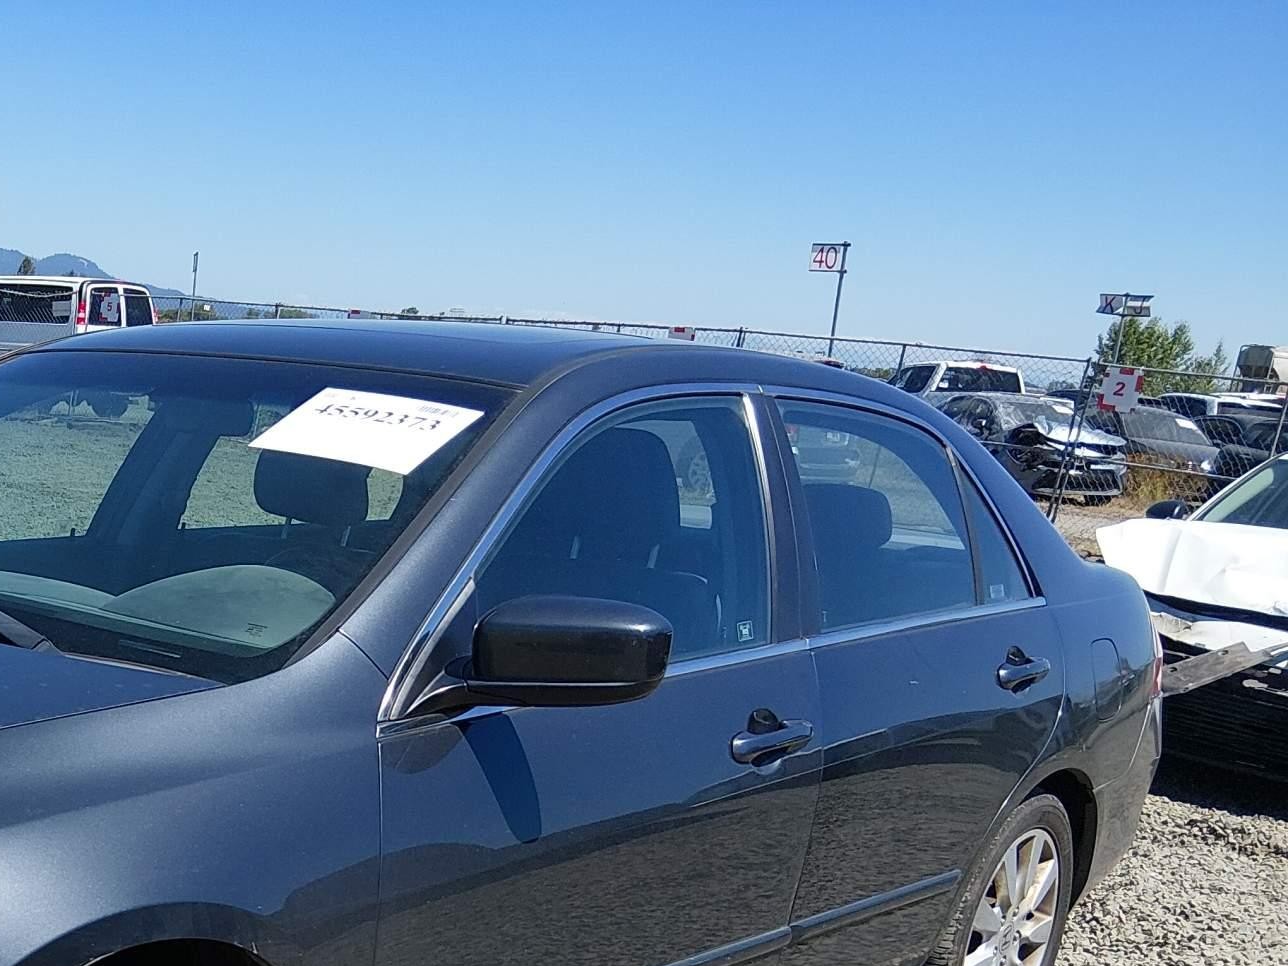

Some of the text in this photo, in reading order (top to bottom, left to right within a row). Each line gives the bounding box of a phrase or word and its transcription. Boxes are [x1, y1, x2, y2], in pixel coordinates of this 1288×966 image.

[813, 246, 838, 269] 40
[106, 302, 113, 312] 5
[1103, 295, 1116, 314] K
[1134, 297, 1146, 315] J
[1113, 381, 1126, 397] 2
[315, 403, 441, 431] 45592373
